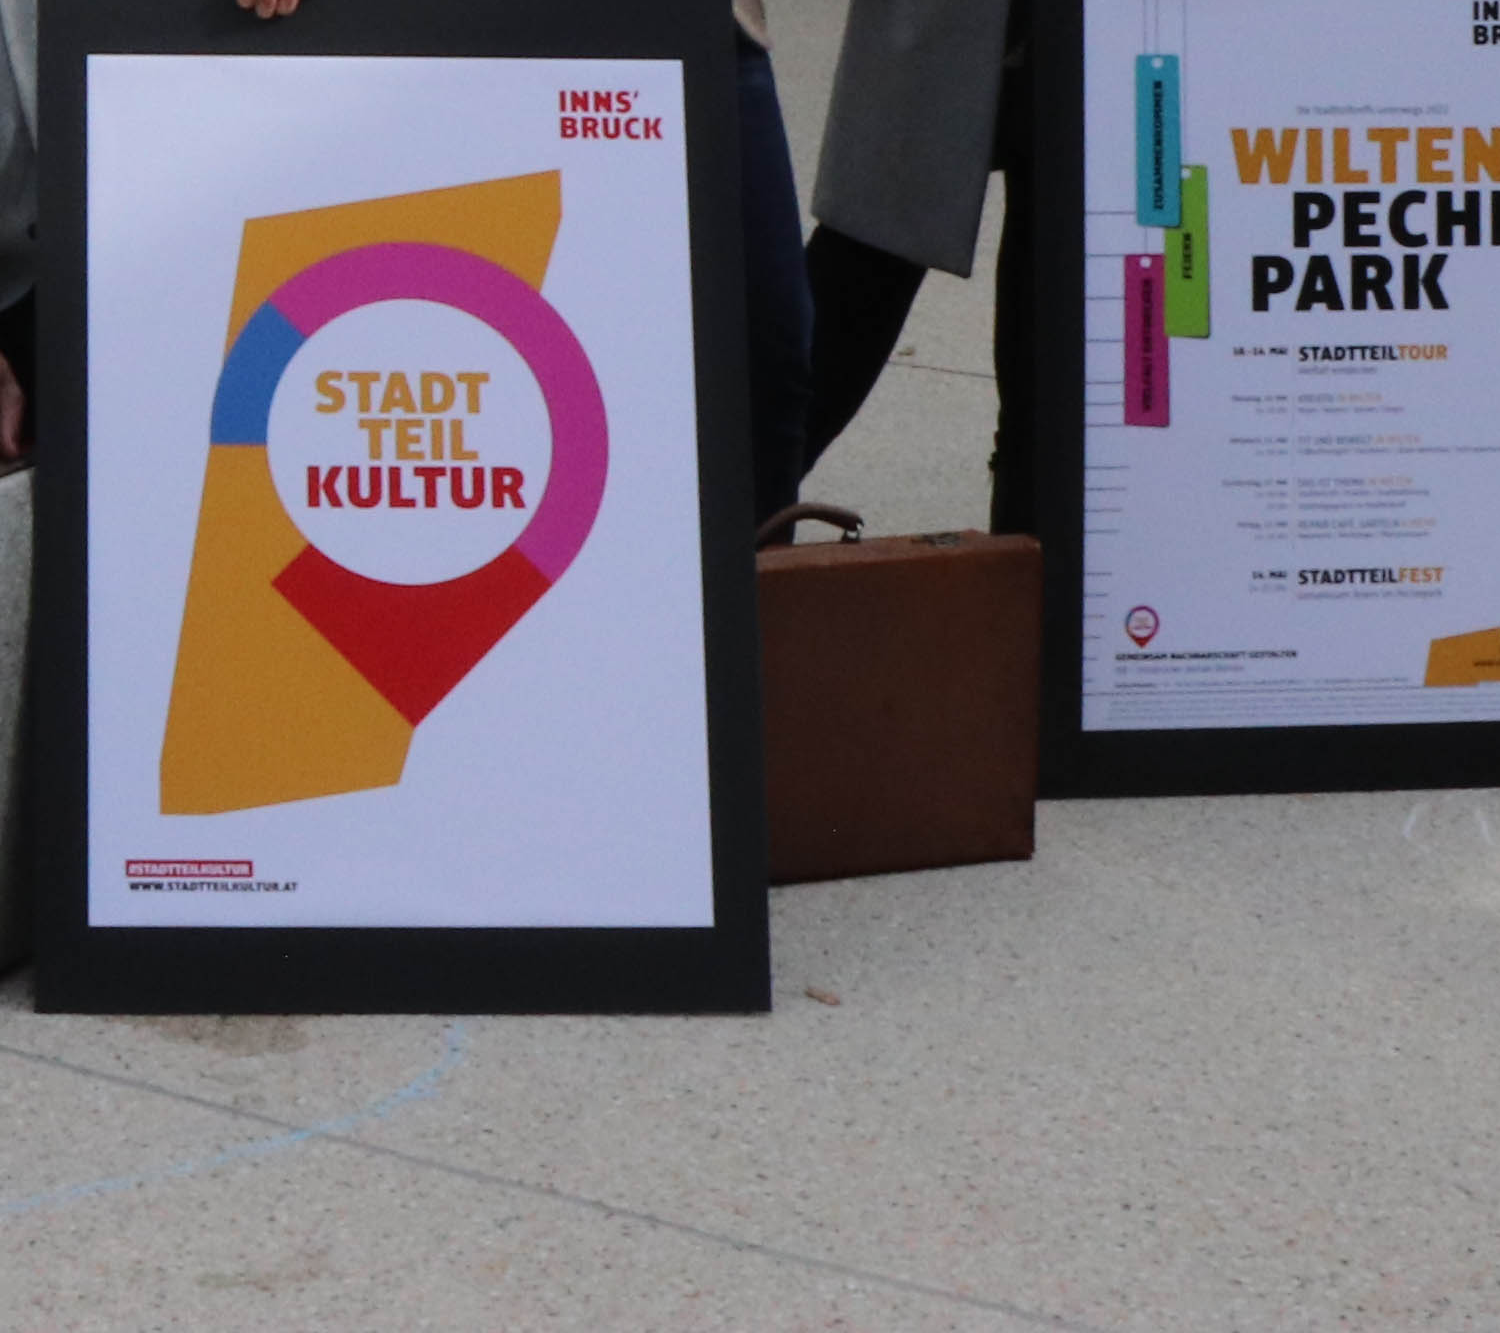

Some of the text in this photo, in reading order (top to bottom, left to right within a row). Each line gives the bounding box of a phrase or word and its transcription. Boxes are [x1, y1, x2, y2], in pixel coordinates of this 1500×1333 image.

[559, 90, 639, 113] INNS'
[560, 116, 663, 140] BRUCK
[1251, 253, 1450, 312] PARK
[1298, 344, 1448, 362] STADTTEILTOUR
[314, 370, 490, 414] STADT
[358, 418, 479, 461] TEIL
[306, 465, 526, 509] KULTUR
[1298, 567, 1444, 585] STADTTEILFEST
